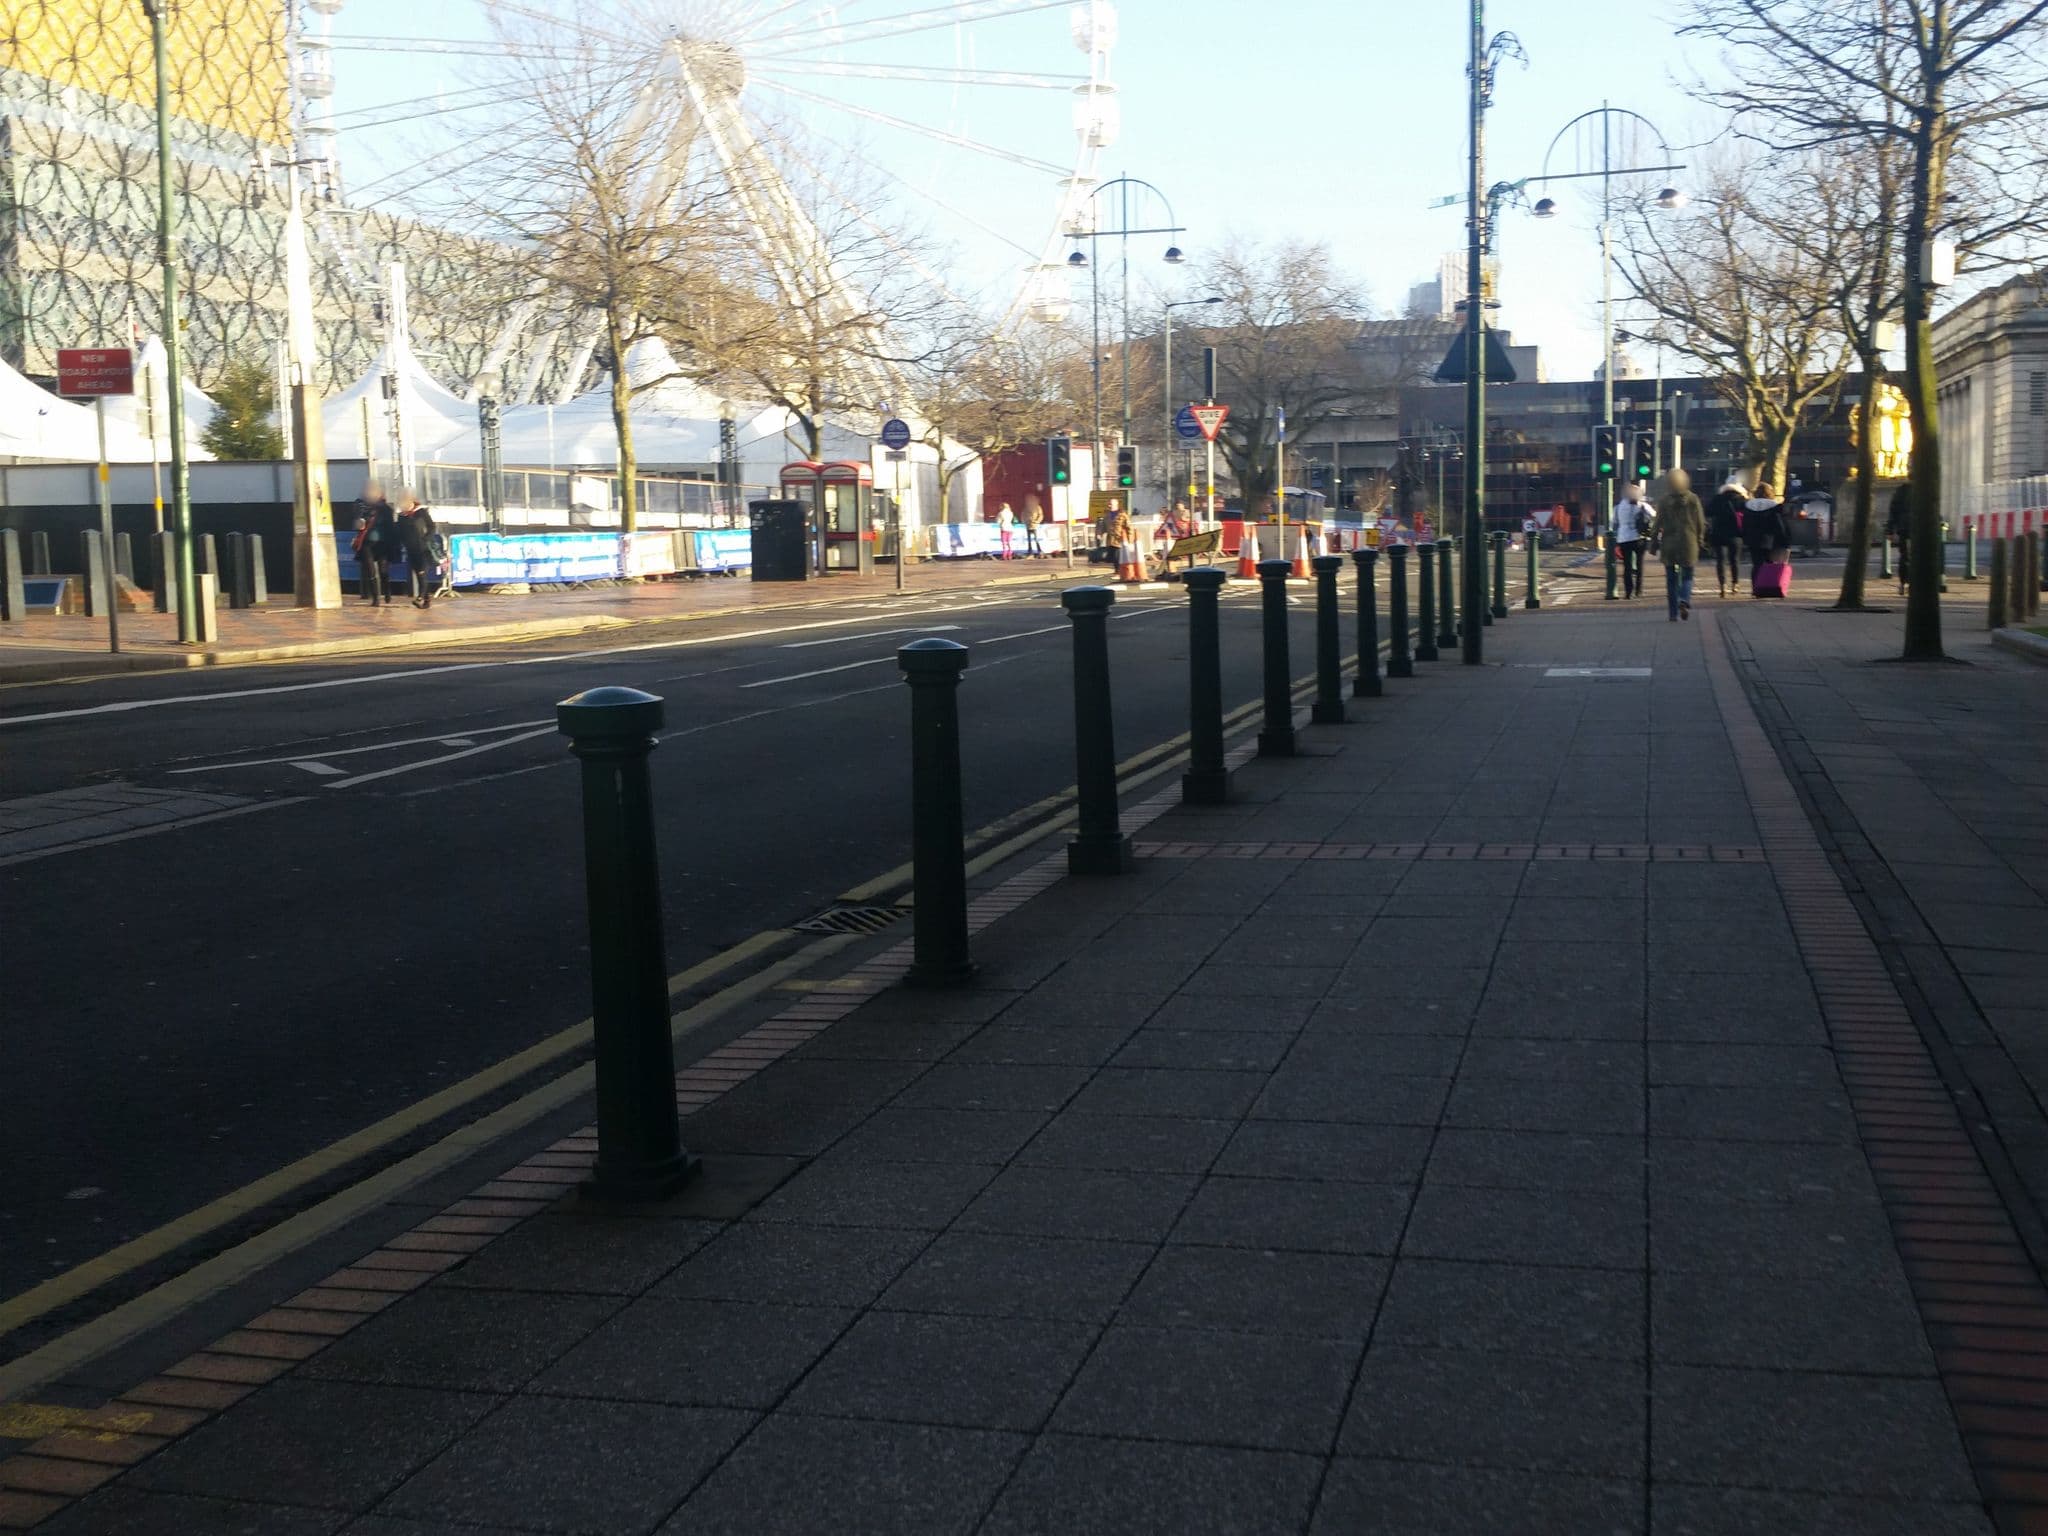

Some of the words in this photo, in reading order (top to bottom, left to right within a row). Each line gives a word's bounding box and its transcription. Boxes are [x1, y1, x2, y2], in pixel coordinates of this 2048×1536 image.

[80, 354, 106, 362] NEW
[59, 367, 89, 377] ROAD
[91, 367, 131, 377] LAYOUT
[77, 381, 113, 389] AHEAD
[1199, 410, 1221, 418] GIVE
